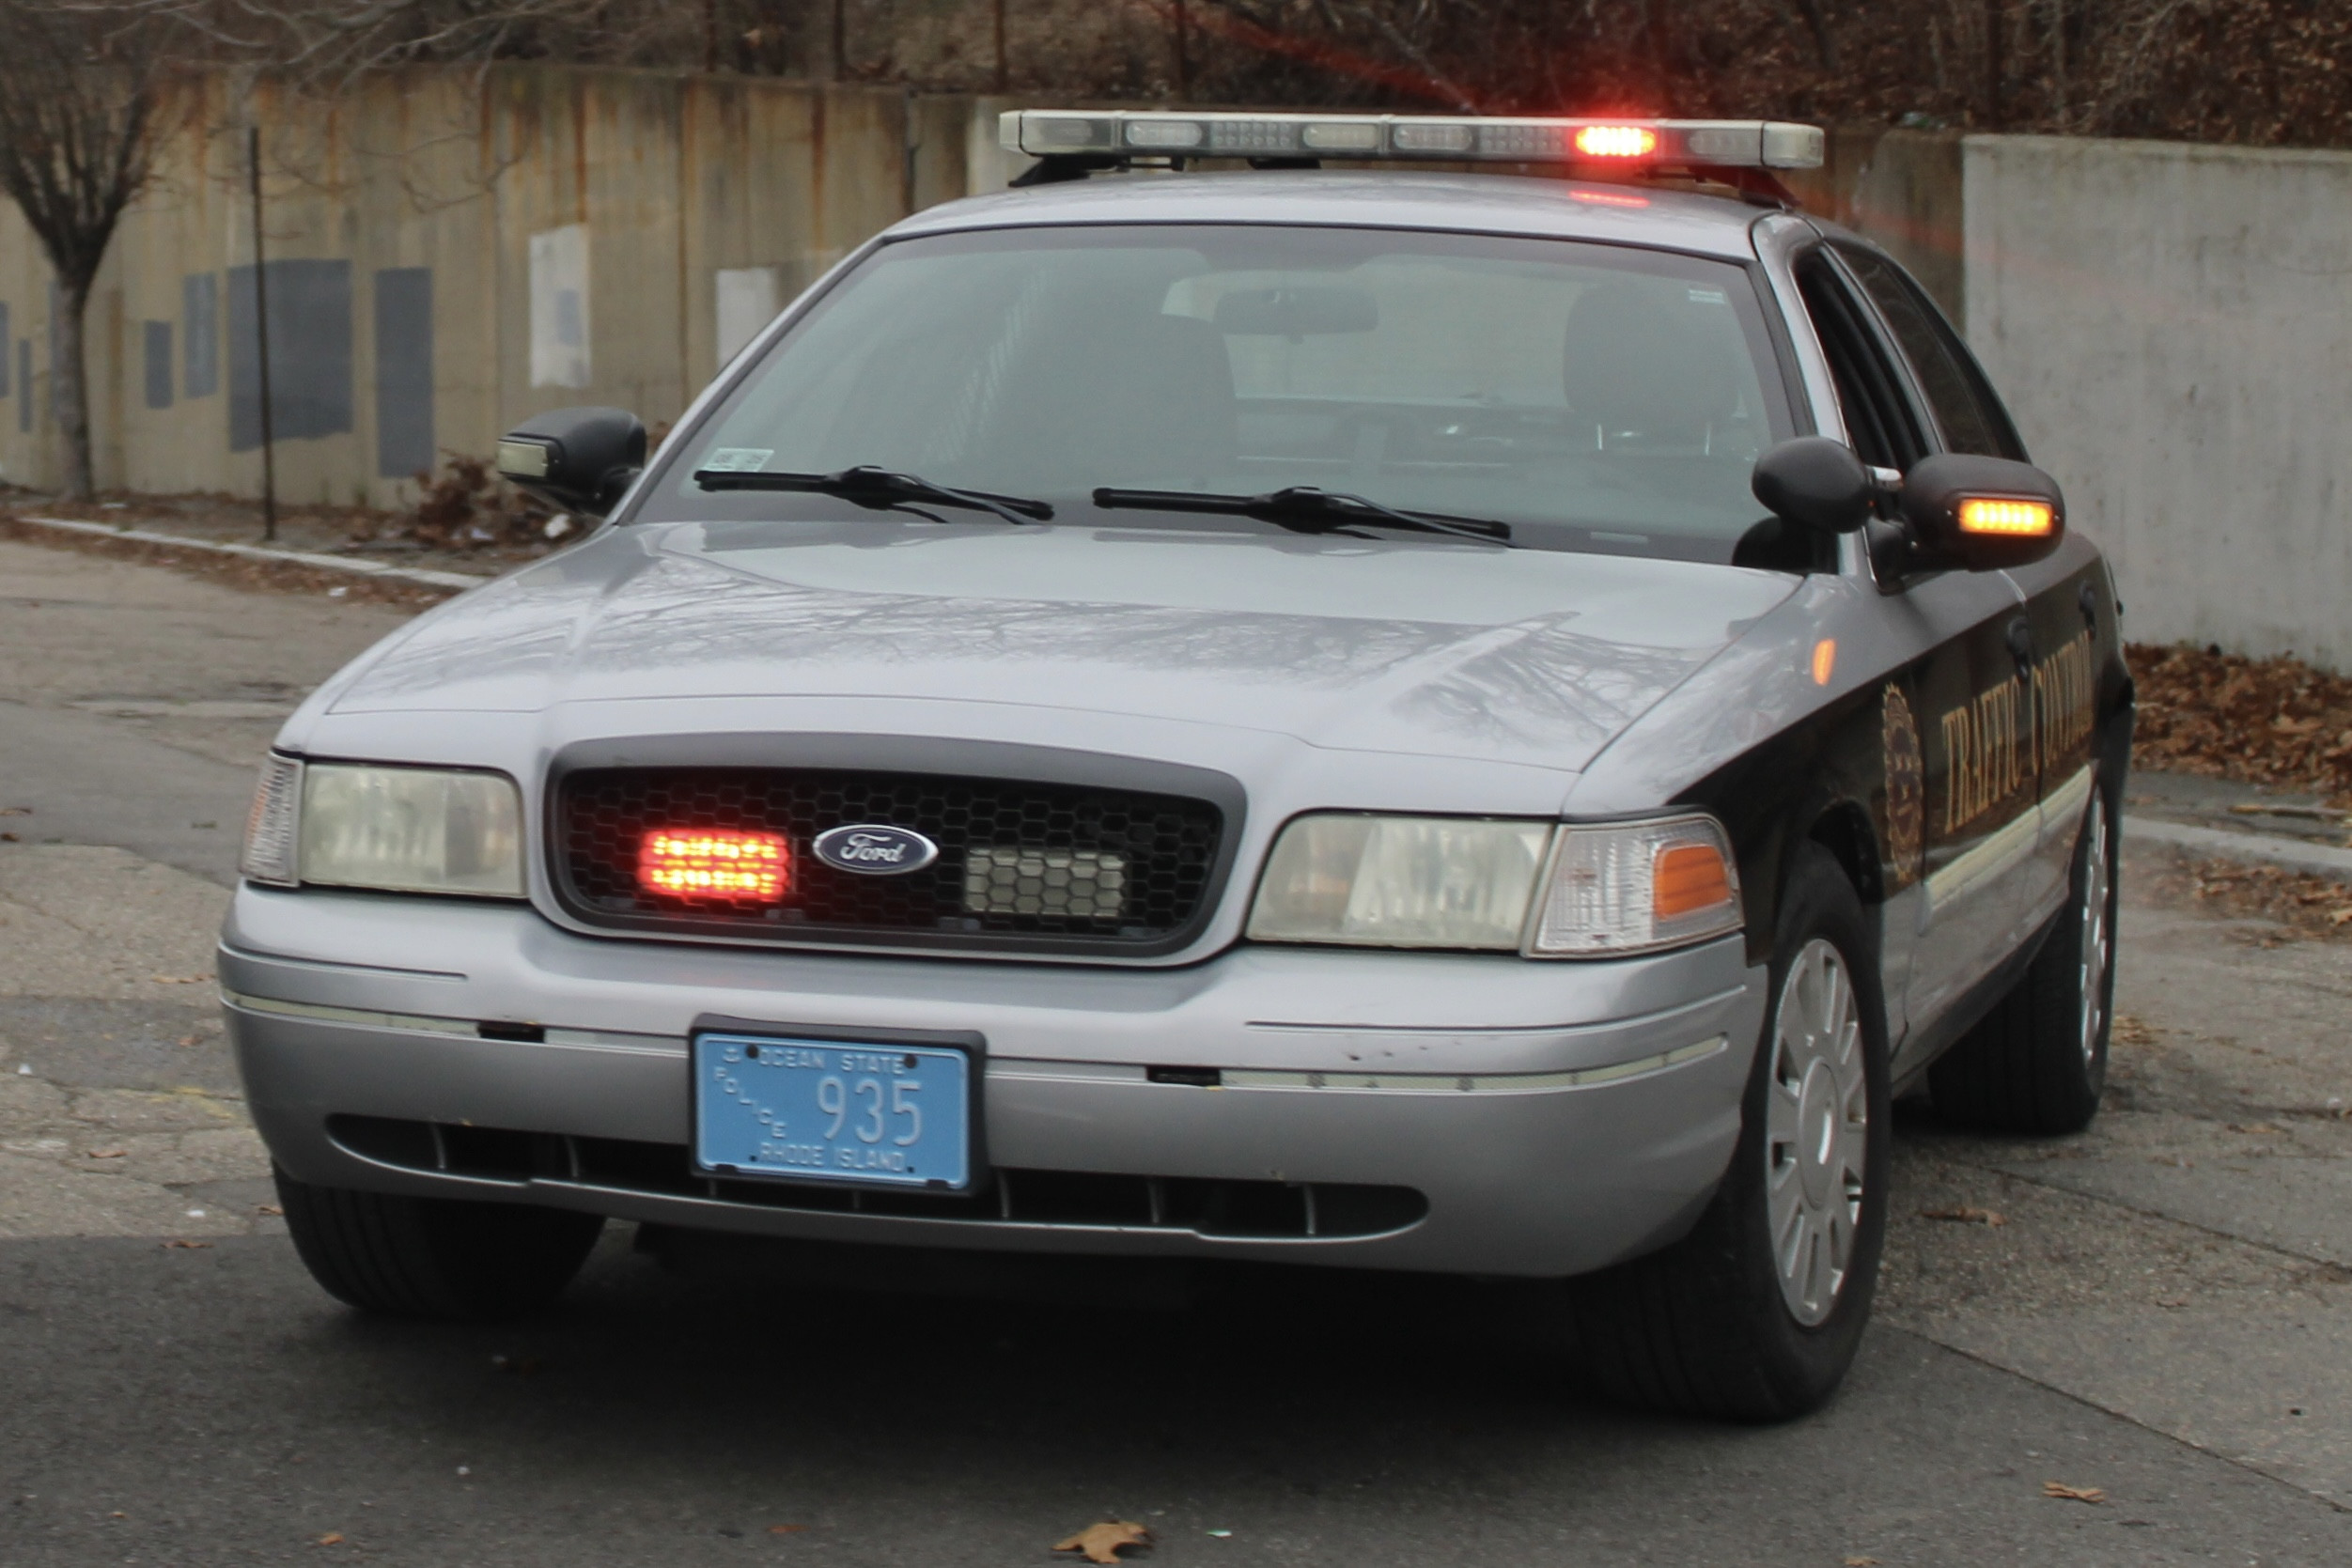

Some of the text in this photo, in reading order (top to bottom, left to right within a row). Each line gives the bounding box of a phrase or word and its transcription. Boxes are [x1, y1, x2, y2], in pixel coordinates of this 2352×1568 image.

[1941, 674, 2020, 834] TRAFFIC
[840, 833, 907, 862] Ford
[758, 1048, 905, 1076] OCEAN STATE
[817, 1076, 922, 1147] 935
[758, 1141, 906, 1172] RHODE ISLAND
